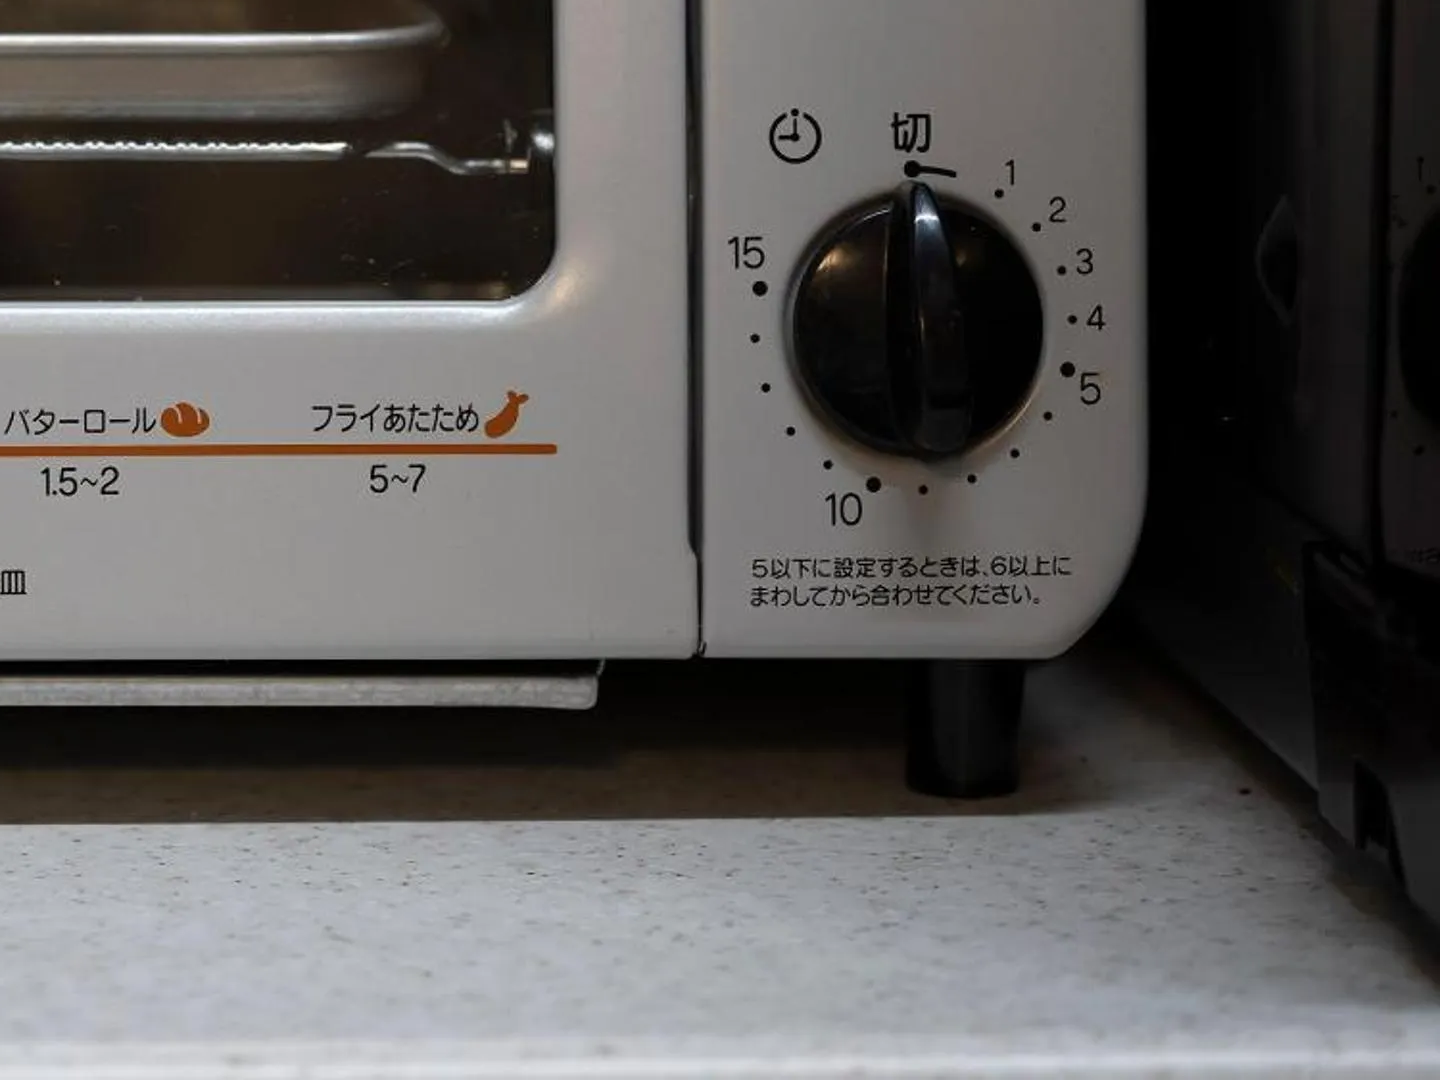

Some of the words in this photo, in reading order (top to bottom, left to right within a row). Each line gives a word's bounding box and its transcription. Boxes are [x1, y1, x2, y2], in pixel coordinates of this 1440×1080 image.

[890, 111, 933, 154] 切
[1005, 159, 1016, 186] 1
[1048, 195, 1067, 224] 2
[727, 235, 766, 270] 15
[1076, 247, 1095, 276] 3
[1086, 305, 1107, 331] 4
[1080, 372, 1102, 406] 5
[3, 406, 157, 437] バターロール
[311, 402, 480, 434] フライあたため
[824, 493, 863, 527] 10
[750, 582, 1041, 608] まわしてから合わせてください。
